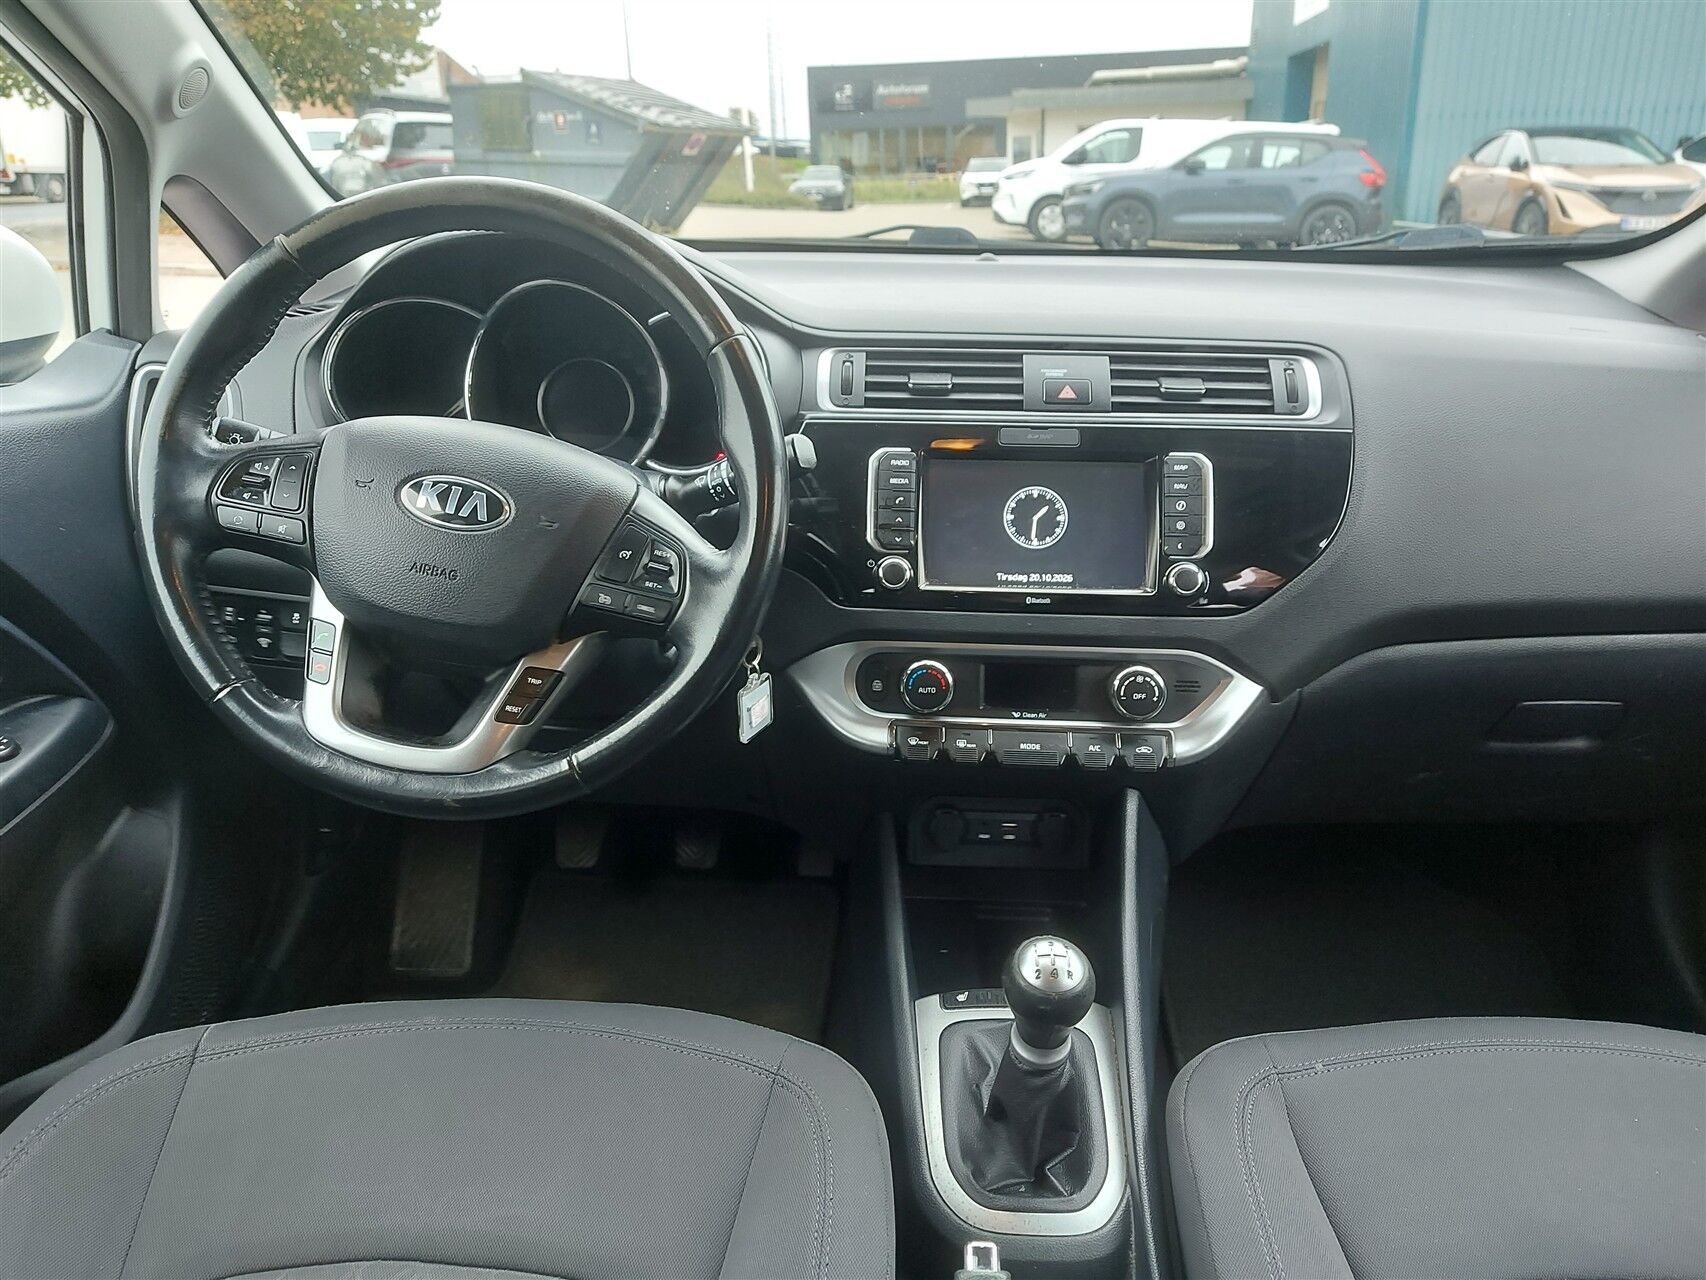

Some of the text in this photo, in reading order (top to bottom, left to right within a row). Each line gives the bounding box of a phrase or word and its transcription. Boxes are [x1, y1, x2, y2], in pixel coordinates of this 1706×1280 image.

[415, 480, 488, 522] KIA
[408, 561, 460, 581] AIRBAG
[996, 572, 1028, 583] Tirsdag
[527, 677, 543, 685] TRIP
[505, 705, 522, 713] RESET
[1035, 968, 1073, 980] 2 4 R
